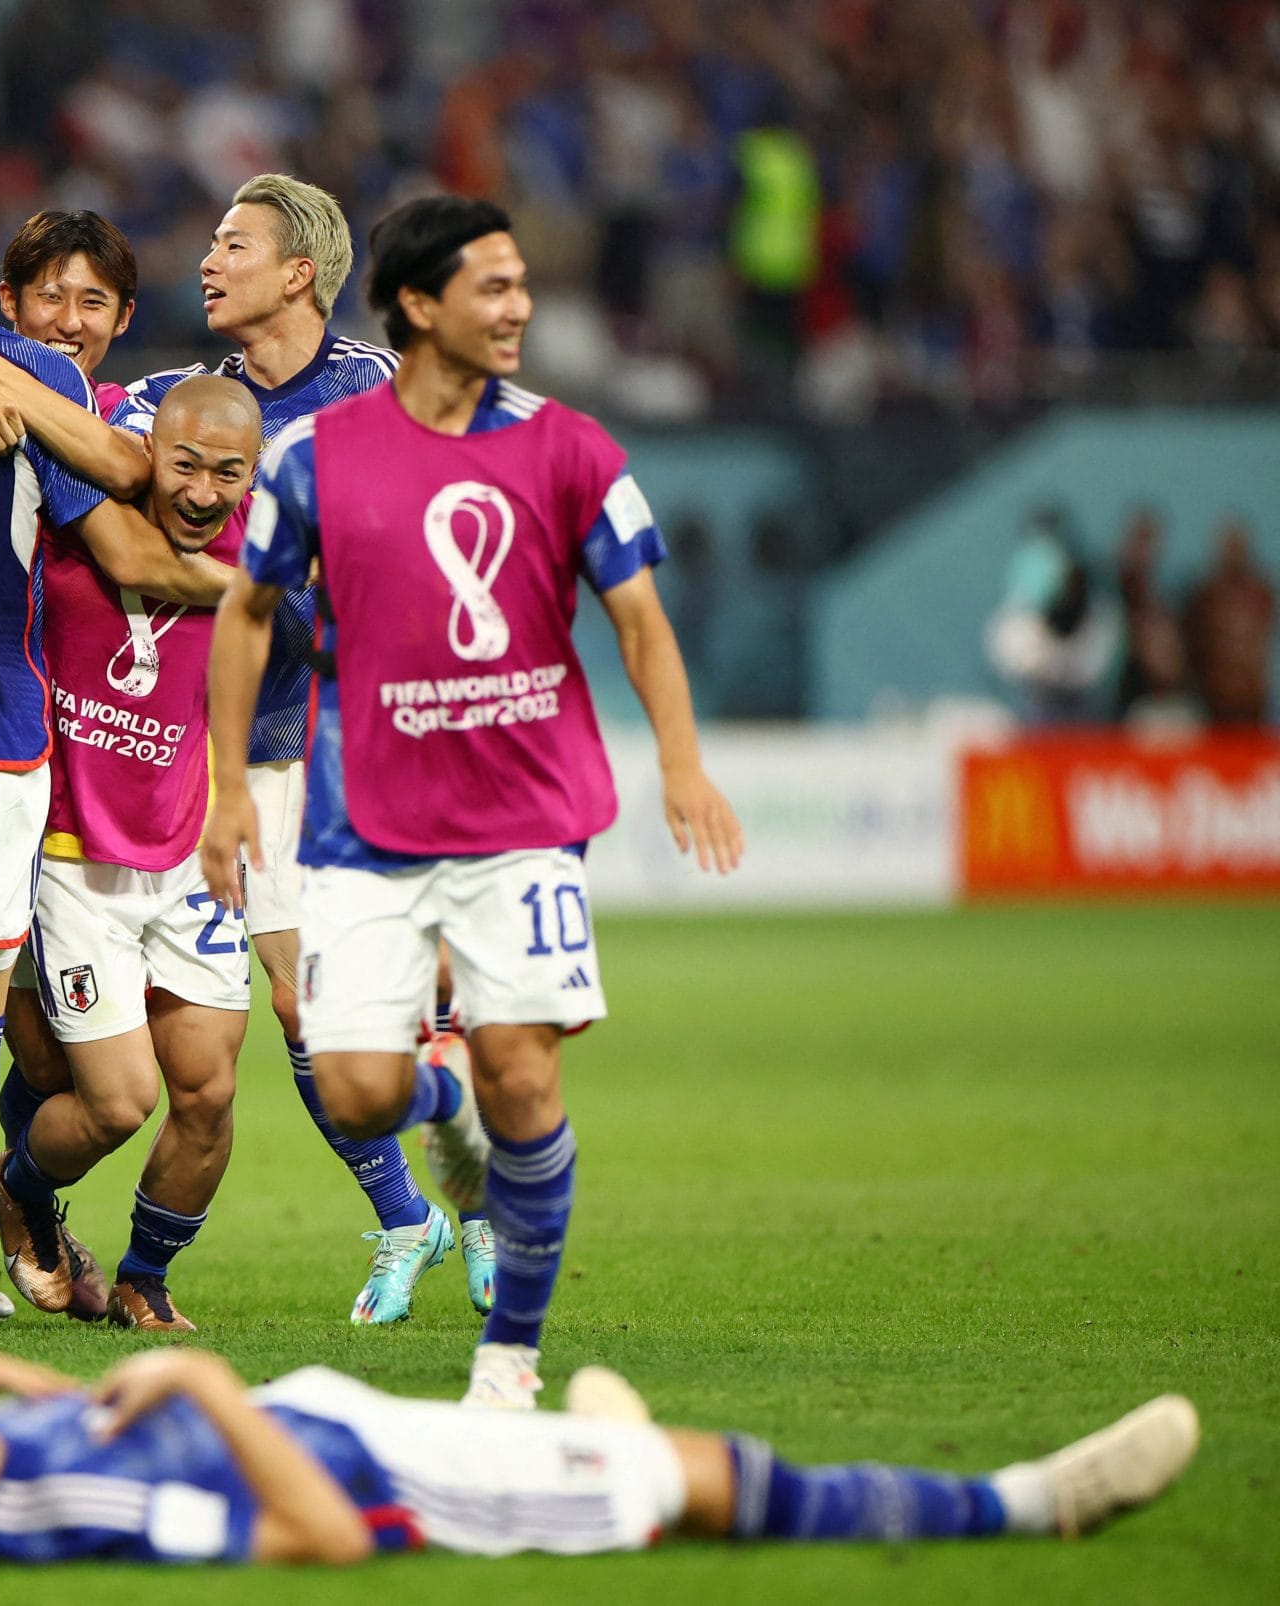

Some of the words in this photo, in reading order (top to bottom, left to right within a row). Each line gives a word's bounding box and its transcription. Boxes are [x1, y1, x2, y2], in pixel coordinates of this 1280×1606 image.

[51, 678, 76, 714] FFA
[80, 697, 161, 738] WORLD
[163, 724, 187, 743] CU
[380, 679, 437, 708] FIFA
[435, 671, 531, 704] WORLD
[530, 663, 568, 692] CUP
[56, 714, 177, 768] atar202
[185, 891, 248, 955] 2
[520, 883, 589, 956] 10
